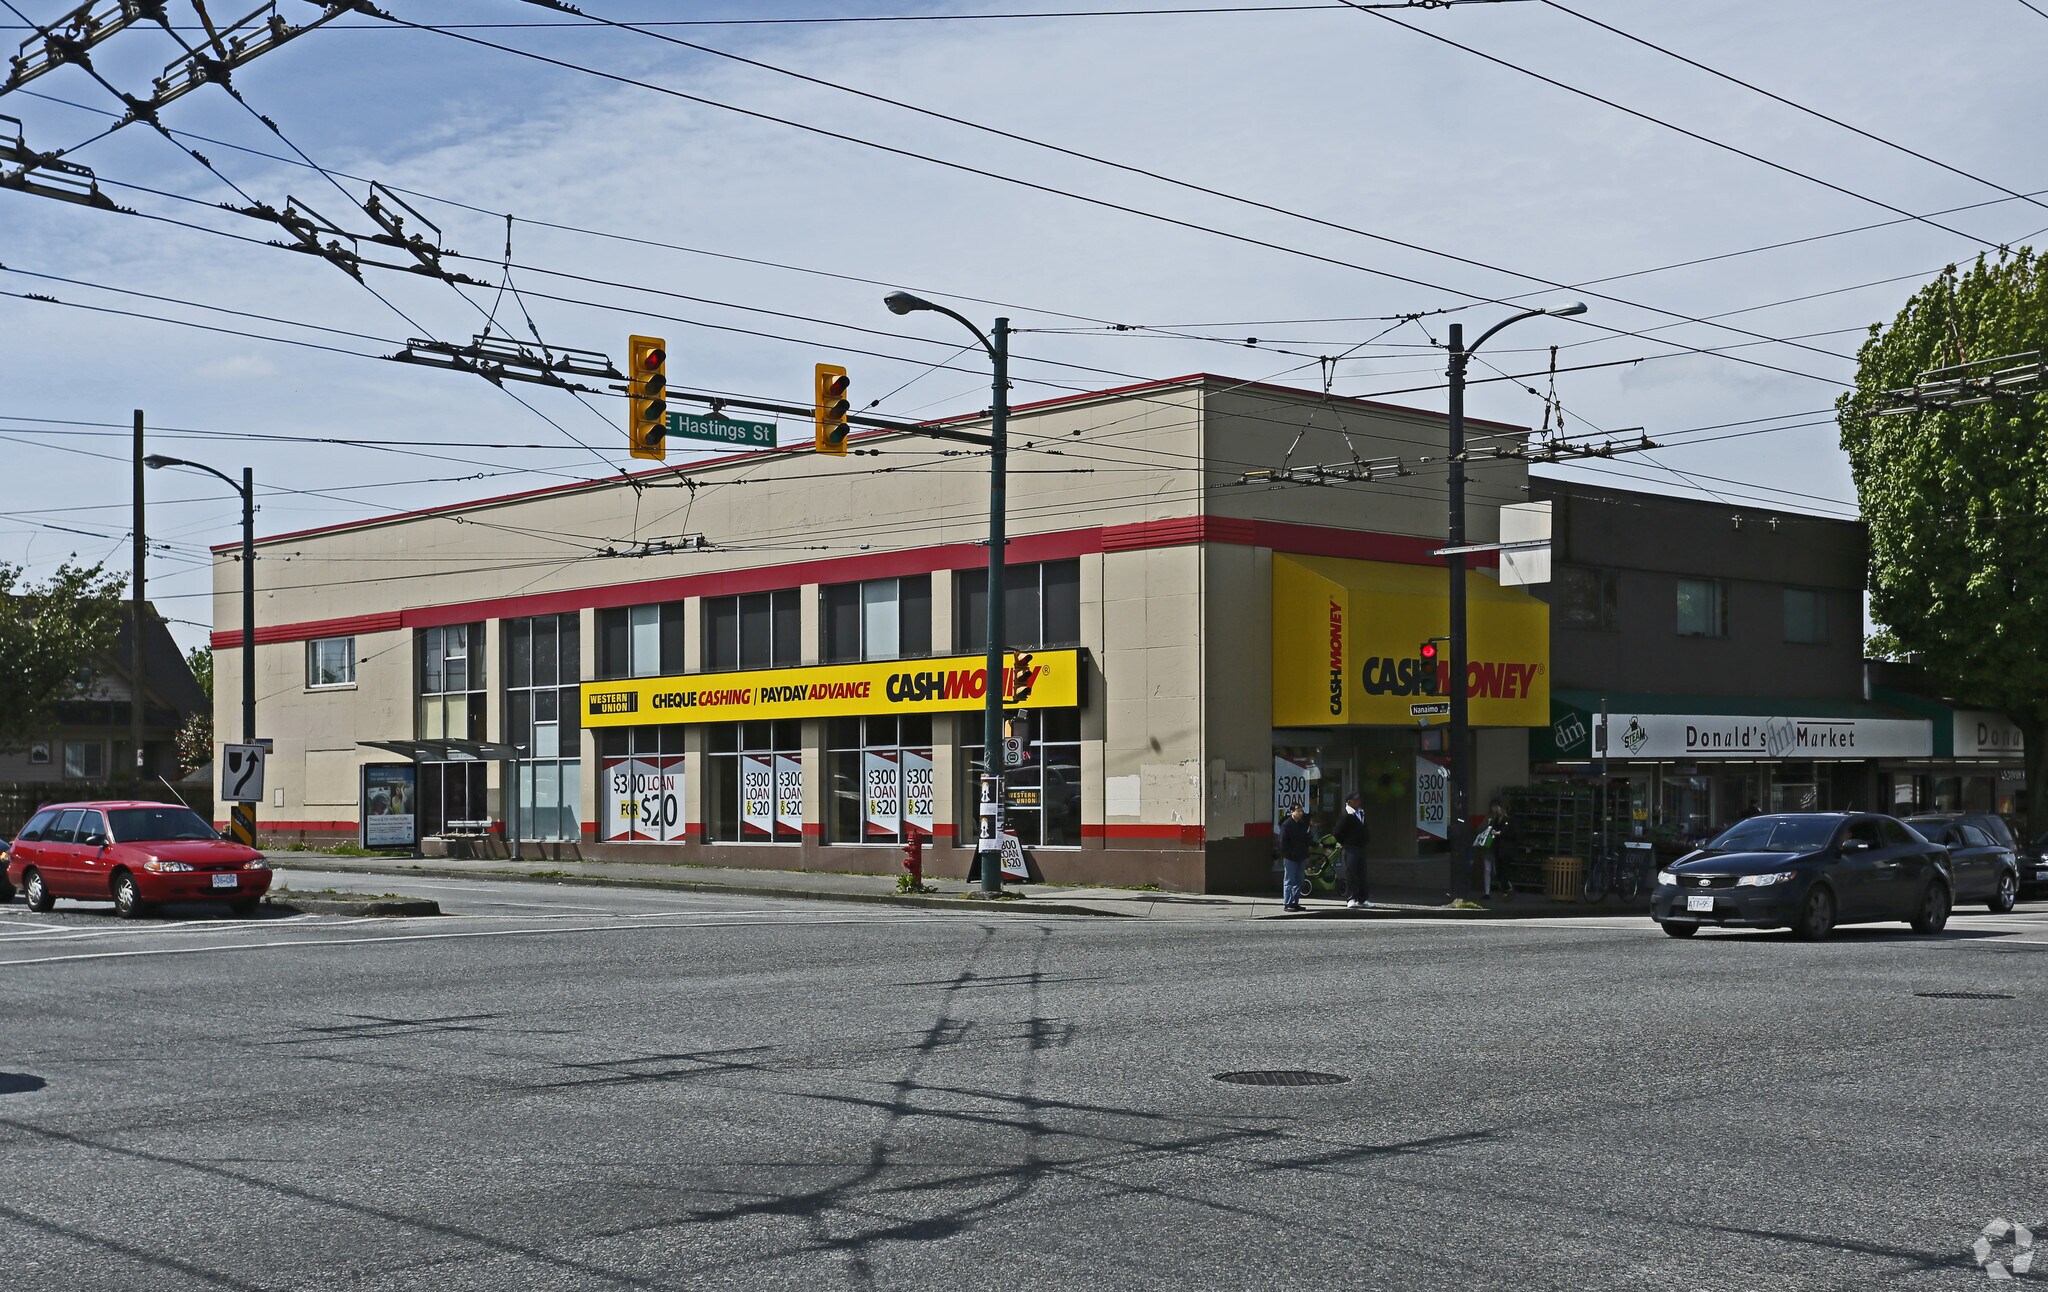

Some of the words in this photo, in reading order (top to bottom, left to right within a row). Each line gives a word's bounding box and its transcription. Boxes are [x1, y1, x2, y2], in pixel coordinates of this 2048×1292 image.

[678, 415, 746, 441] Hastings
[753, 424, 770, 441] St
[886, 665, 1042, 703] CASHMOY
[590, 693, 628, 704] WESTERN
[652, 691, 697, 709] CHEQUE
[698, 688, 751, 706] CASHING
[760, 684, 809, 703] PAYDAY
[808, 681, 871, 700] ADVANCE
[601, 702, 628, 713] UNION
[1413, 705, 1439, 714] Nanaimo
[1624, 727, 1646, 748] STEAM
[1686, 725, 1767, 748] Donald's
[1796, 726, 1855, 748] Market
[614, 773, 646, 794] $300
[647, 776, 674, 791] LOAN
[746, 772, 770, 787] $300
[868, 769, 896, 785] $300
[1278, 776, 1306, 793] $300
[1418, 774, 1444, 790] $300
[746, 787, 770, 800] LOAN
[779, 787, 802, 800] LOAN
[869, 786, 896, 798] LOAN
[907, 785, 933, 798] LOAN
[1419, 791, 1444, 804] LOAN
[752, 801, 770, 815] $20
[877, 799, 897, 815] $20
[1278, 794, 1306, 808] LOAN
[621, 803, 638, 816] FOR
[641, 794, 678, 827] $20
[1425, 805, 1444, 820] $20
